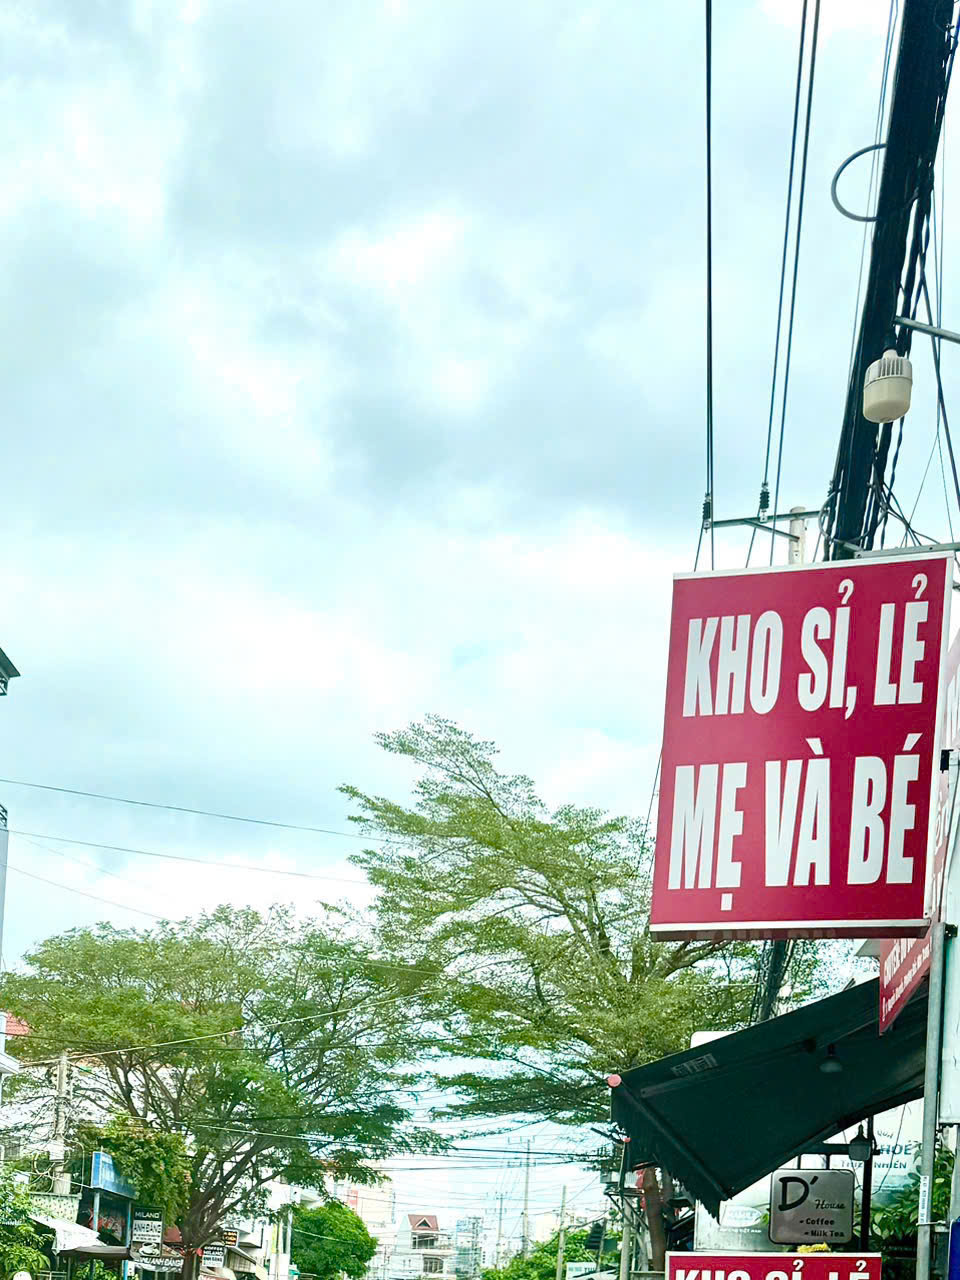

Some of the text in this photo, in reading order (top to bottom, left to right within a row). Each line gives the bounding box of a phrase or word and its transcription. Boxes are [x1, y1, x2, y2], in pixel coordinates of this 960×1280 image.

[682, 572, 929, 720] KHO SỈ, LẺ
[667, 762, 748, 911] MẸ
[764, 737, 830, 888] VÀ
[847, 732, 923, 885] BÉ
[815, 1199, 846, 1210] House
[135, 1211, 160, 1219] MILANO
[805, 1217, 835, 1226] Coffee
[810, 1229, 845, 1238] Milk Tea
